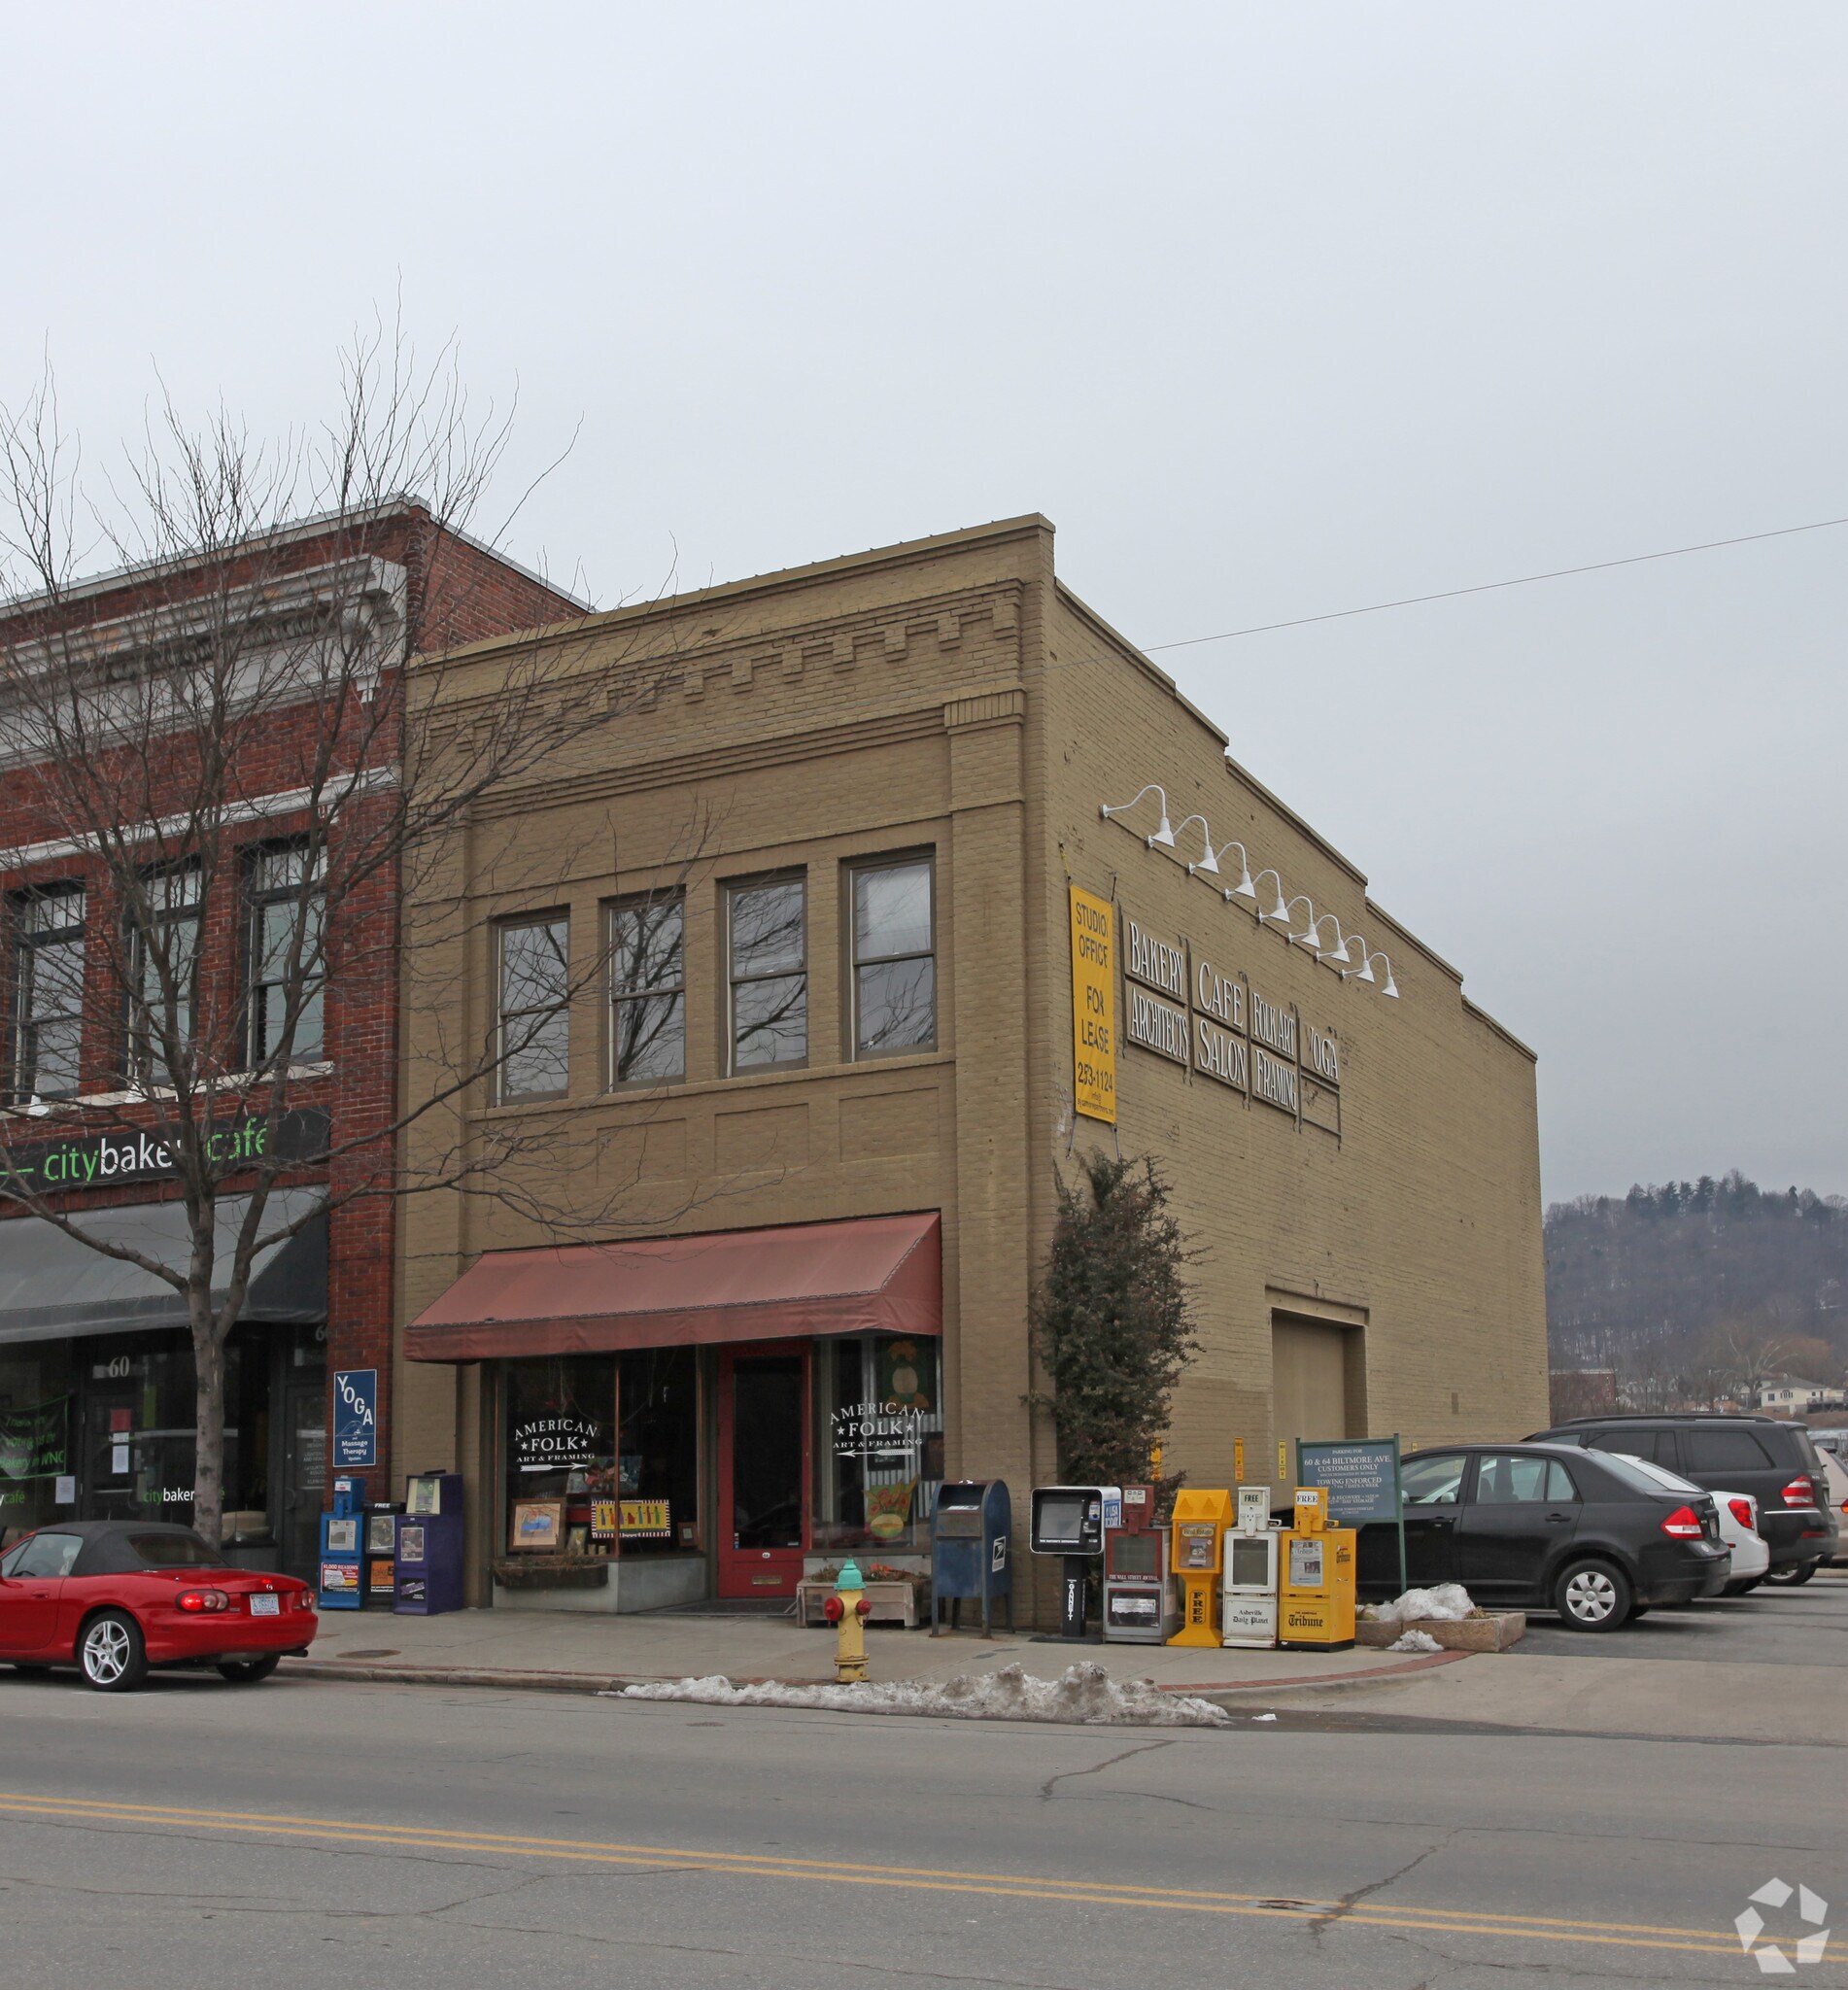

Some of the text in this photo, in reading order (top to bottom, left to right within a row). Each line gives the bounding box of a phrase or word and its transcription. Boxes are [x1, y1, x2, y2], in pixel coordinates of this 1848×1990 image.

[1078, 934, 1108, 969] OFFICE
[1129, 921, 1182, 996] BAKERY
[1086, 984, 1105, 1017] FOR
[1199, 962, 1244, 1029] CAFE
[1080, 1018, 1109, 1054] LEASE
[1130, 987, 1188, 1060] ARCHITECTS
[1252, 992, 1294, 1056] FOLK ART
[1199, 1019, 1246, 1087] SALON
[1078, 1061, 1113, 1092] 253-1124
[1255, 1049, 1296, 1112] FRAMING
[44, 1132, 183, 1183] citybake
[108, 1355, 130, 1378] 60
[337, 1375, 373, 1426] YOGA
[830, 1401, 925, 1426] AMERICAN
[515, 1419, 598, 1441] AMERICAN
[848, 1421, 904, 1437] FOLK
[869, 1438, 923, 1447] FRAMING
[530, 1436, 579, 1452] FOLK
[547, 1453, 595, 1461] FRAMING
[1318, 1464, 1359, 1473] CUSTOMERS
[1332, 1456, 1373, 1465] BILTMORE
[142, 1487, 195, 1506] citybaker
[1296, 1494, 1318, 1503] FREE
[1192, 1592, 1204, 1624] FREE
[1232, 1616, 1249, 1625] Daily
[1288, 1614, 1323, 1627] Tribune
